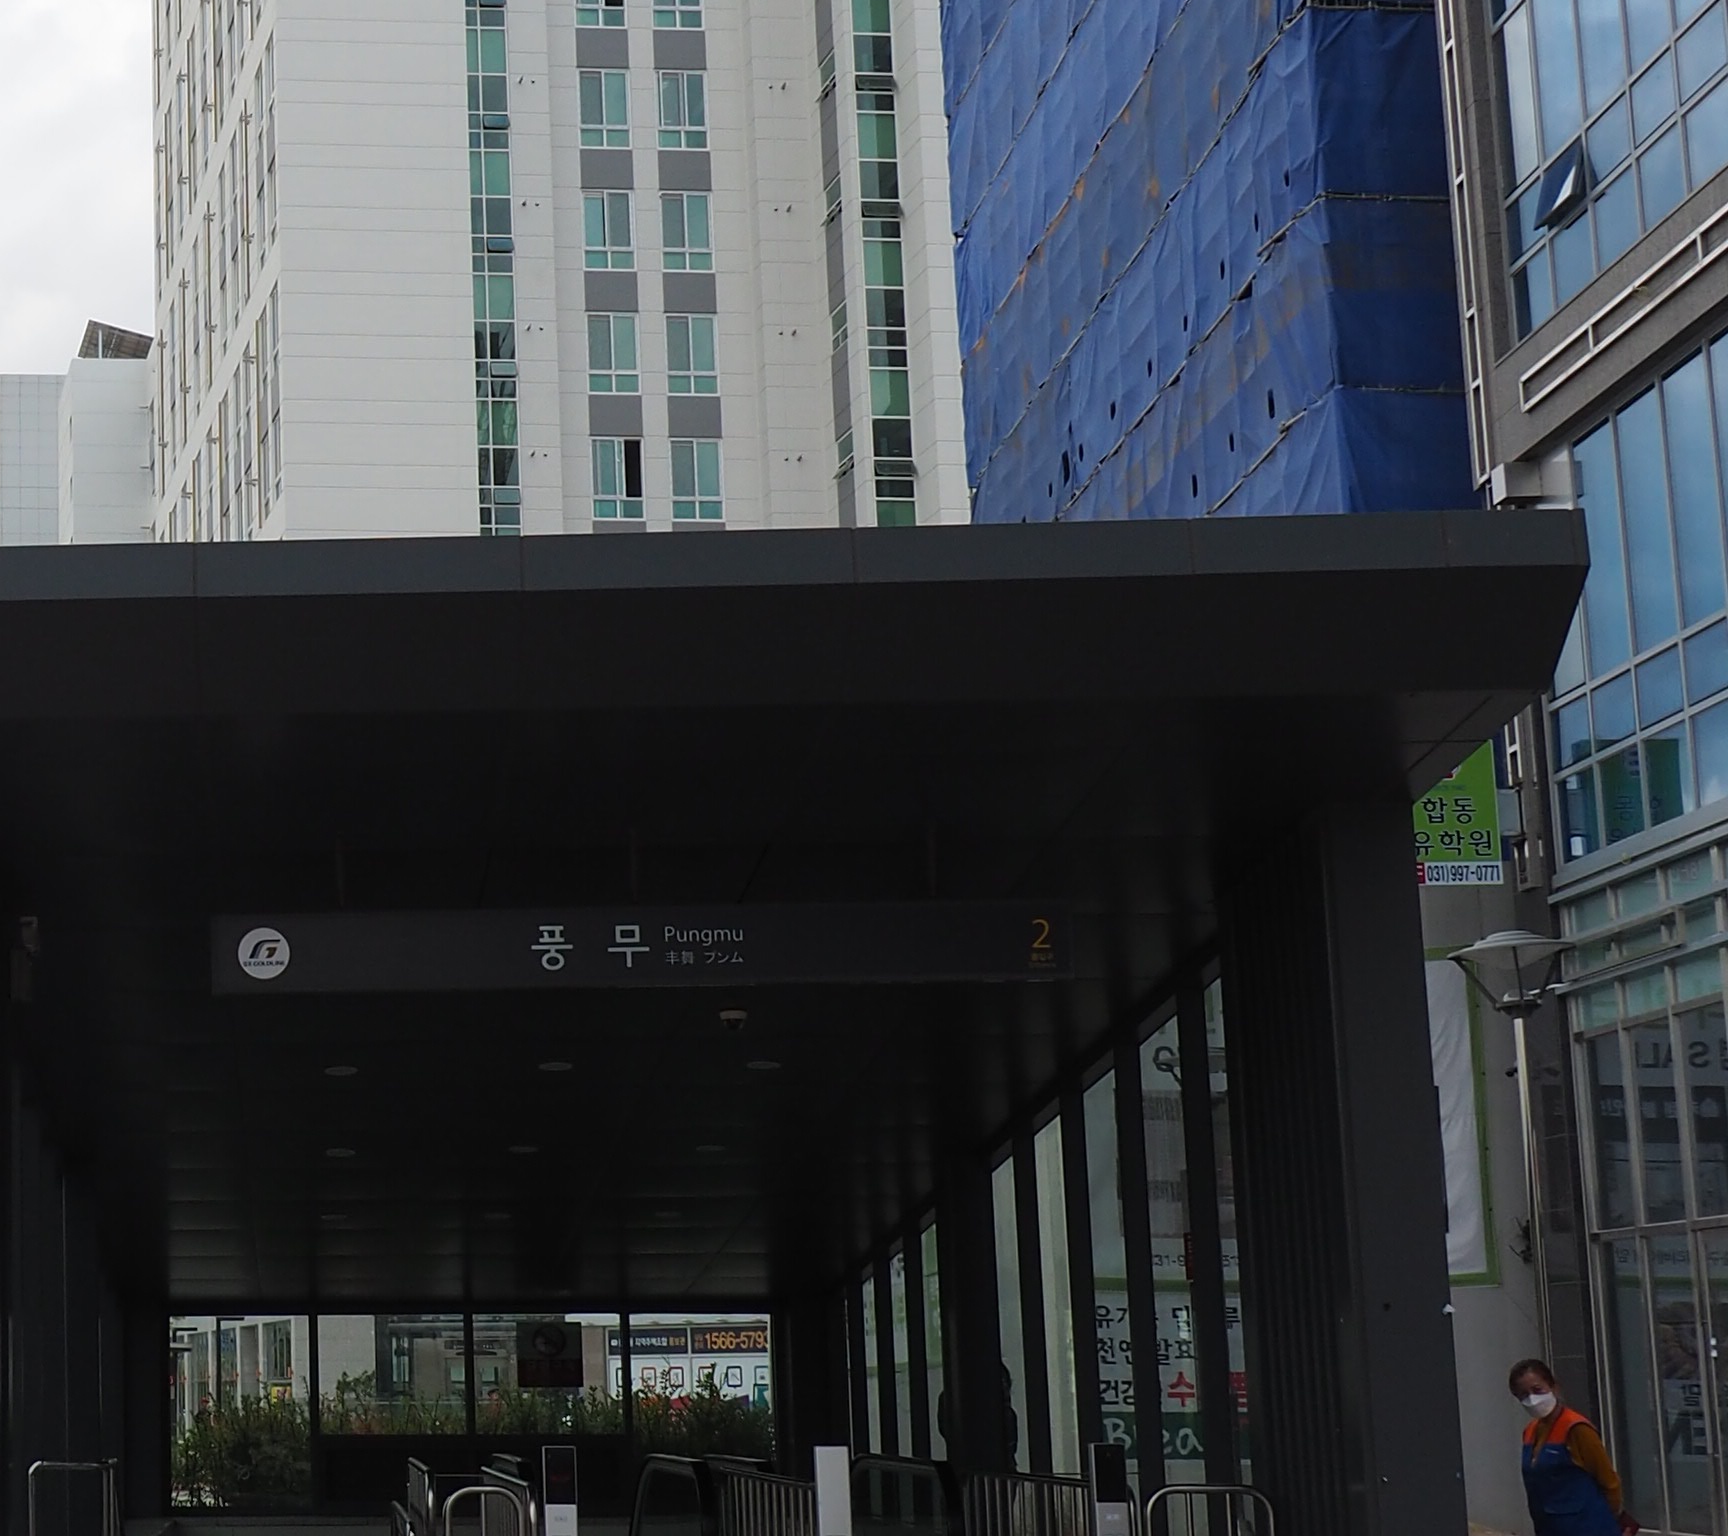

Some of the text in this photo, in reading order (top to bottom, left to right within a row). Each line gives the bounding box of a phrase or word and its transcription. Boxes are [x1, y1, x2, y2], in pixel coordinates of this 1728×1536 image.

[1420, 797, 1477, 824] 합동
[530, 924, 651, 971] 풍 무
[663, 925, 745, 946] Pungmu
[1031, 918, 1052, 949] 2
